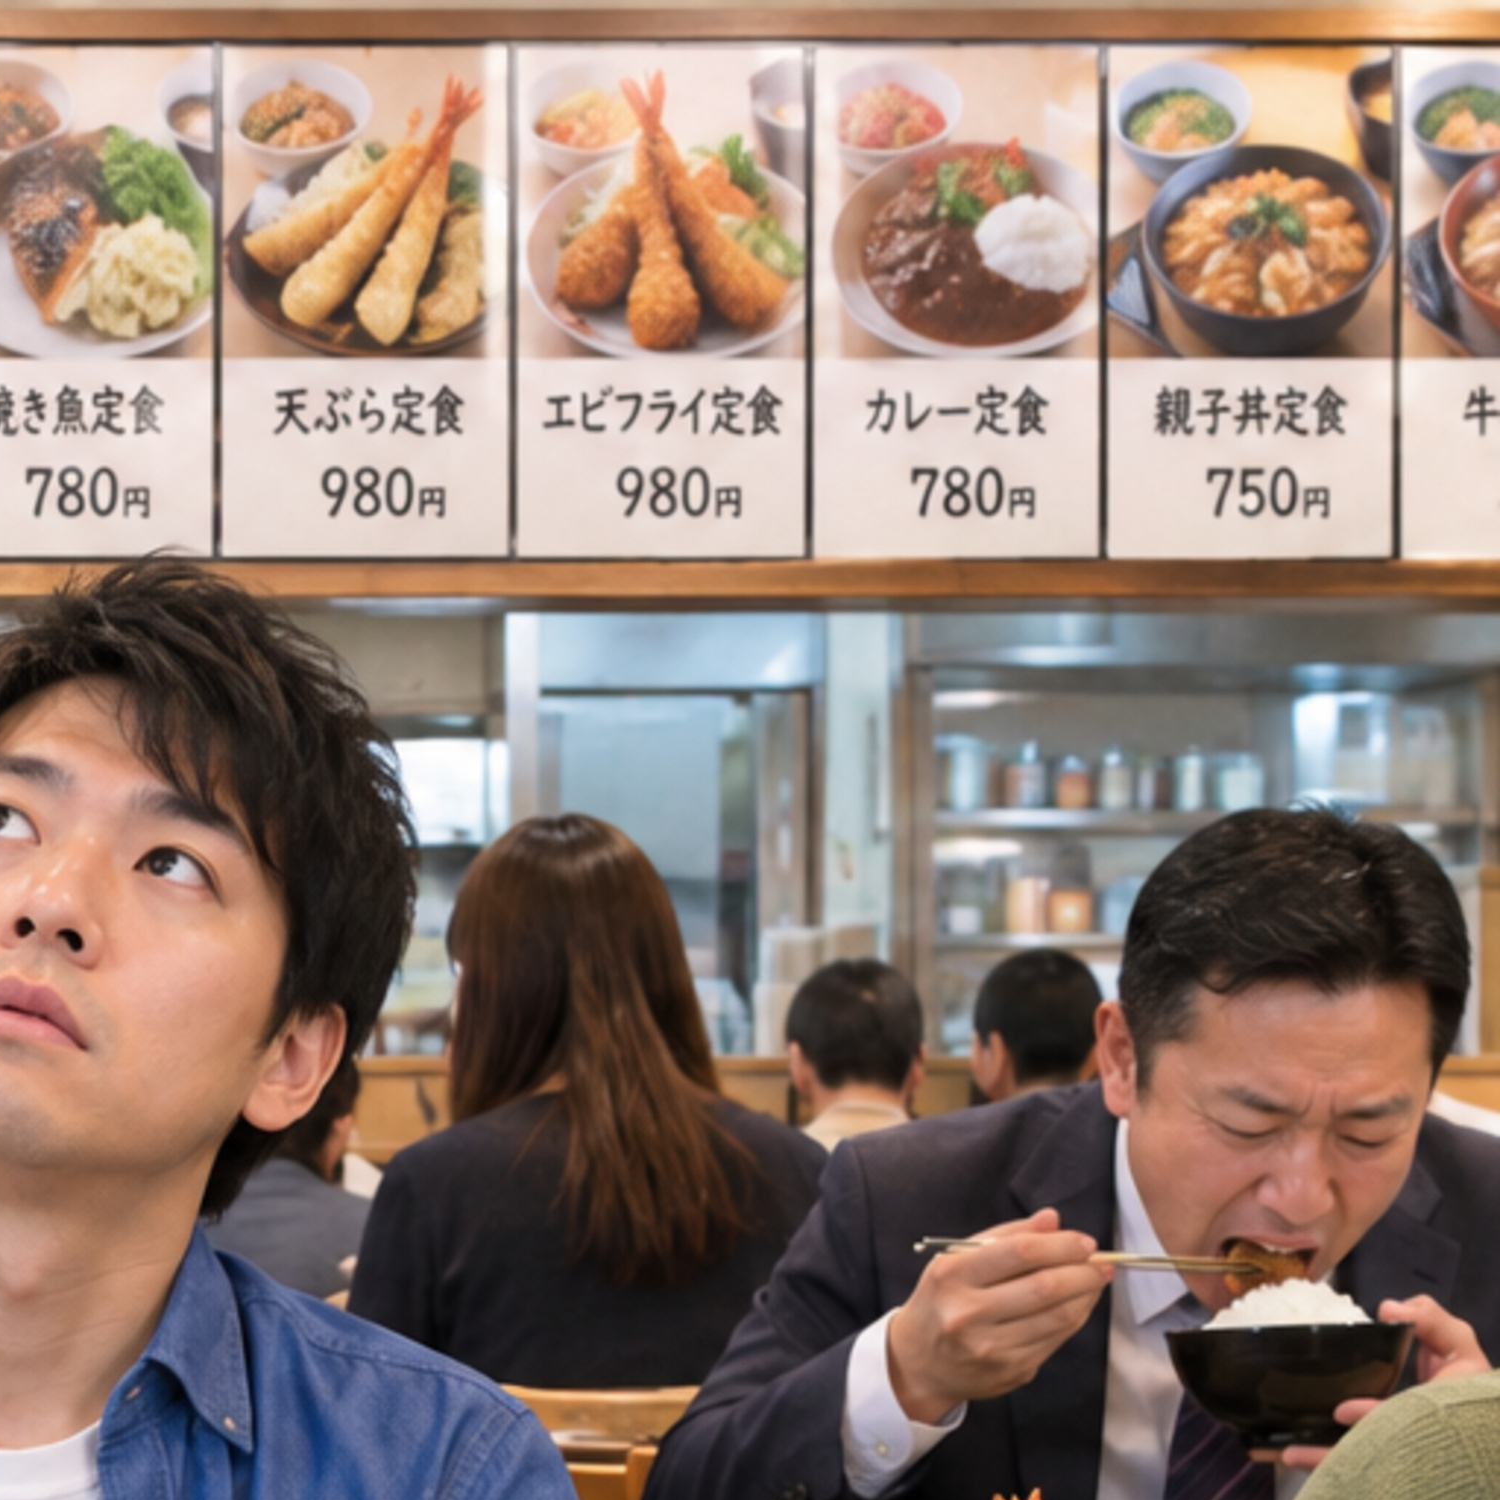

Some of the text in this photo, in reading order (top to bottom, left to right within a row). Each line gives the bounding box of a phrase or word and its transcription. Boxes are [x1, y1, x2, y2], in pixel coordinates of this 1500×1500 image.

[543, 385, 783, 436] エビフライ定食
[866, 385, 1049, 436] カレー定食
[25, 467, 151, 518] 780円
[320, 466, 446, 518] 980円
[615, 466, 743, 518] 980円
[910, 466, 1036, 518] 780円
[1205, 466, 1330, 518] 750円
